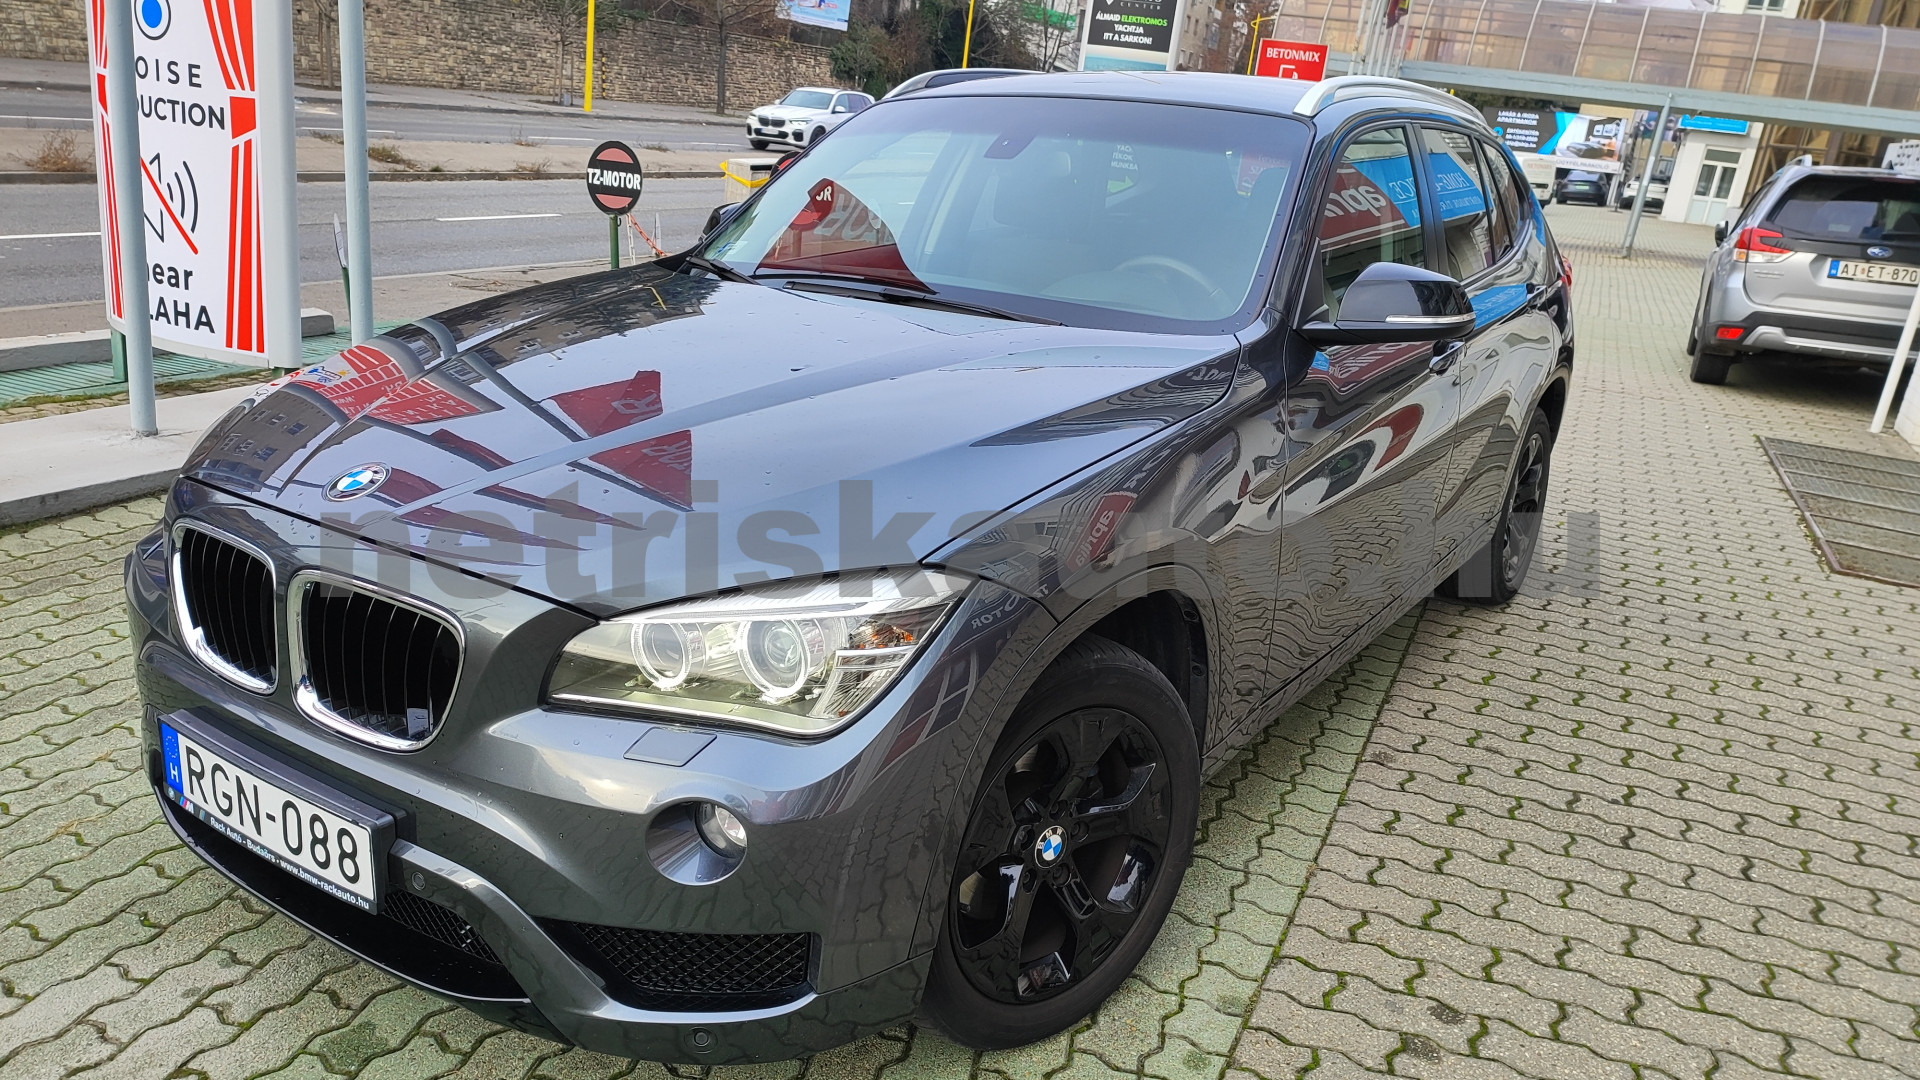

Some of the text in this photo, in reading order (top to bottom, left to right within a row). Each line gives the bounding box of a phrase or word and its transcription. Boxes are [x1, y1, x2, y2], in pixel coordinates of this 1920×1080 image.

[1095, 11, 1168, 26] ÁLMAID ELEKTROMOS
[1120, 2, 1161, 10] CENTER
[1114, 24, 1144, 33] YACHTJA
[1266, 47, 1321, 63] BETONMIX
[135, 56, 202, 88] OISE
[138, 94, 225, 131] UCTION
[587, 168, 641, 190] TZ-MOTOR
[147, 262, 193, 291] ear
[1841, 263, 1859, 277] AI
[1866, 266, 1918, 283] ET-870
[150, 295, 215, 334] AHA
[169, 745, 360, 885] H RGN-088
[210, 816, 226, 833] Rack
[246, 838, 276, 863] Budaörs
[280, 859, 370, 910] www.bmw-rackauto.hu
